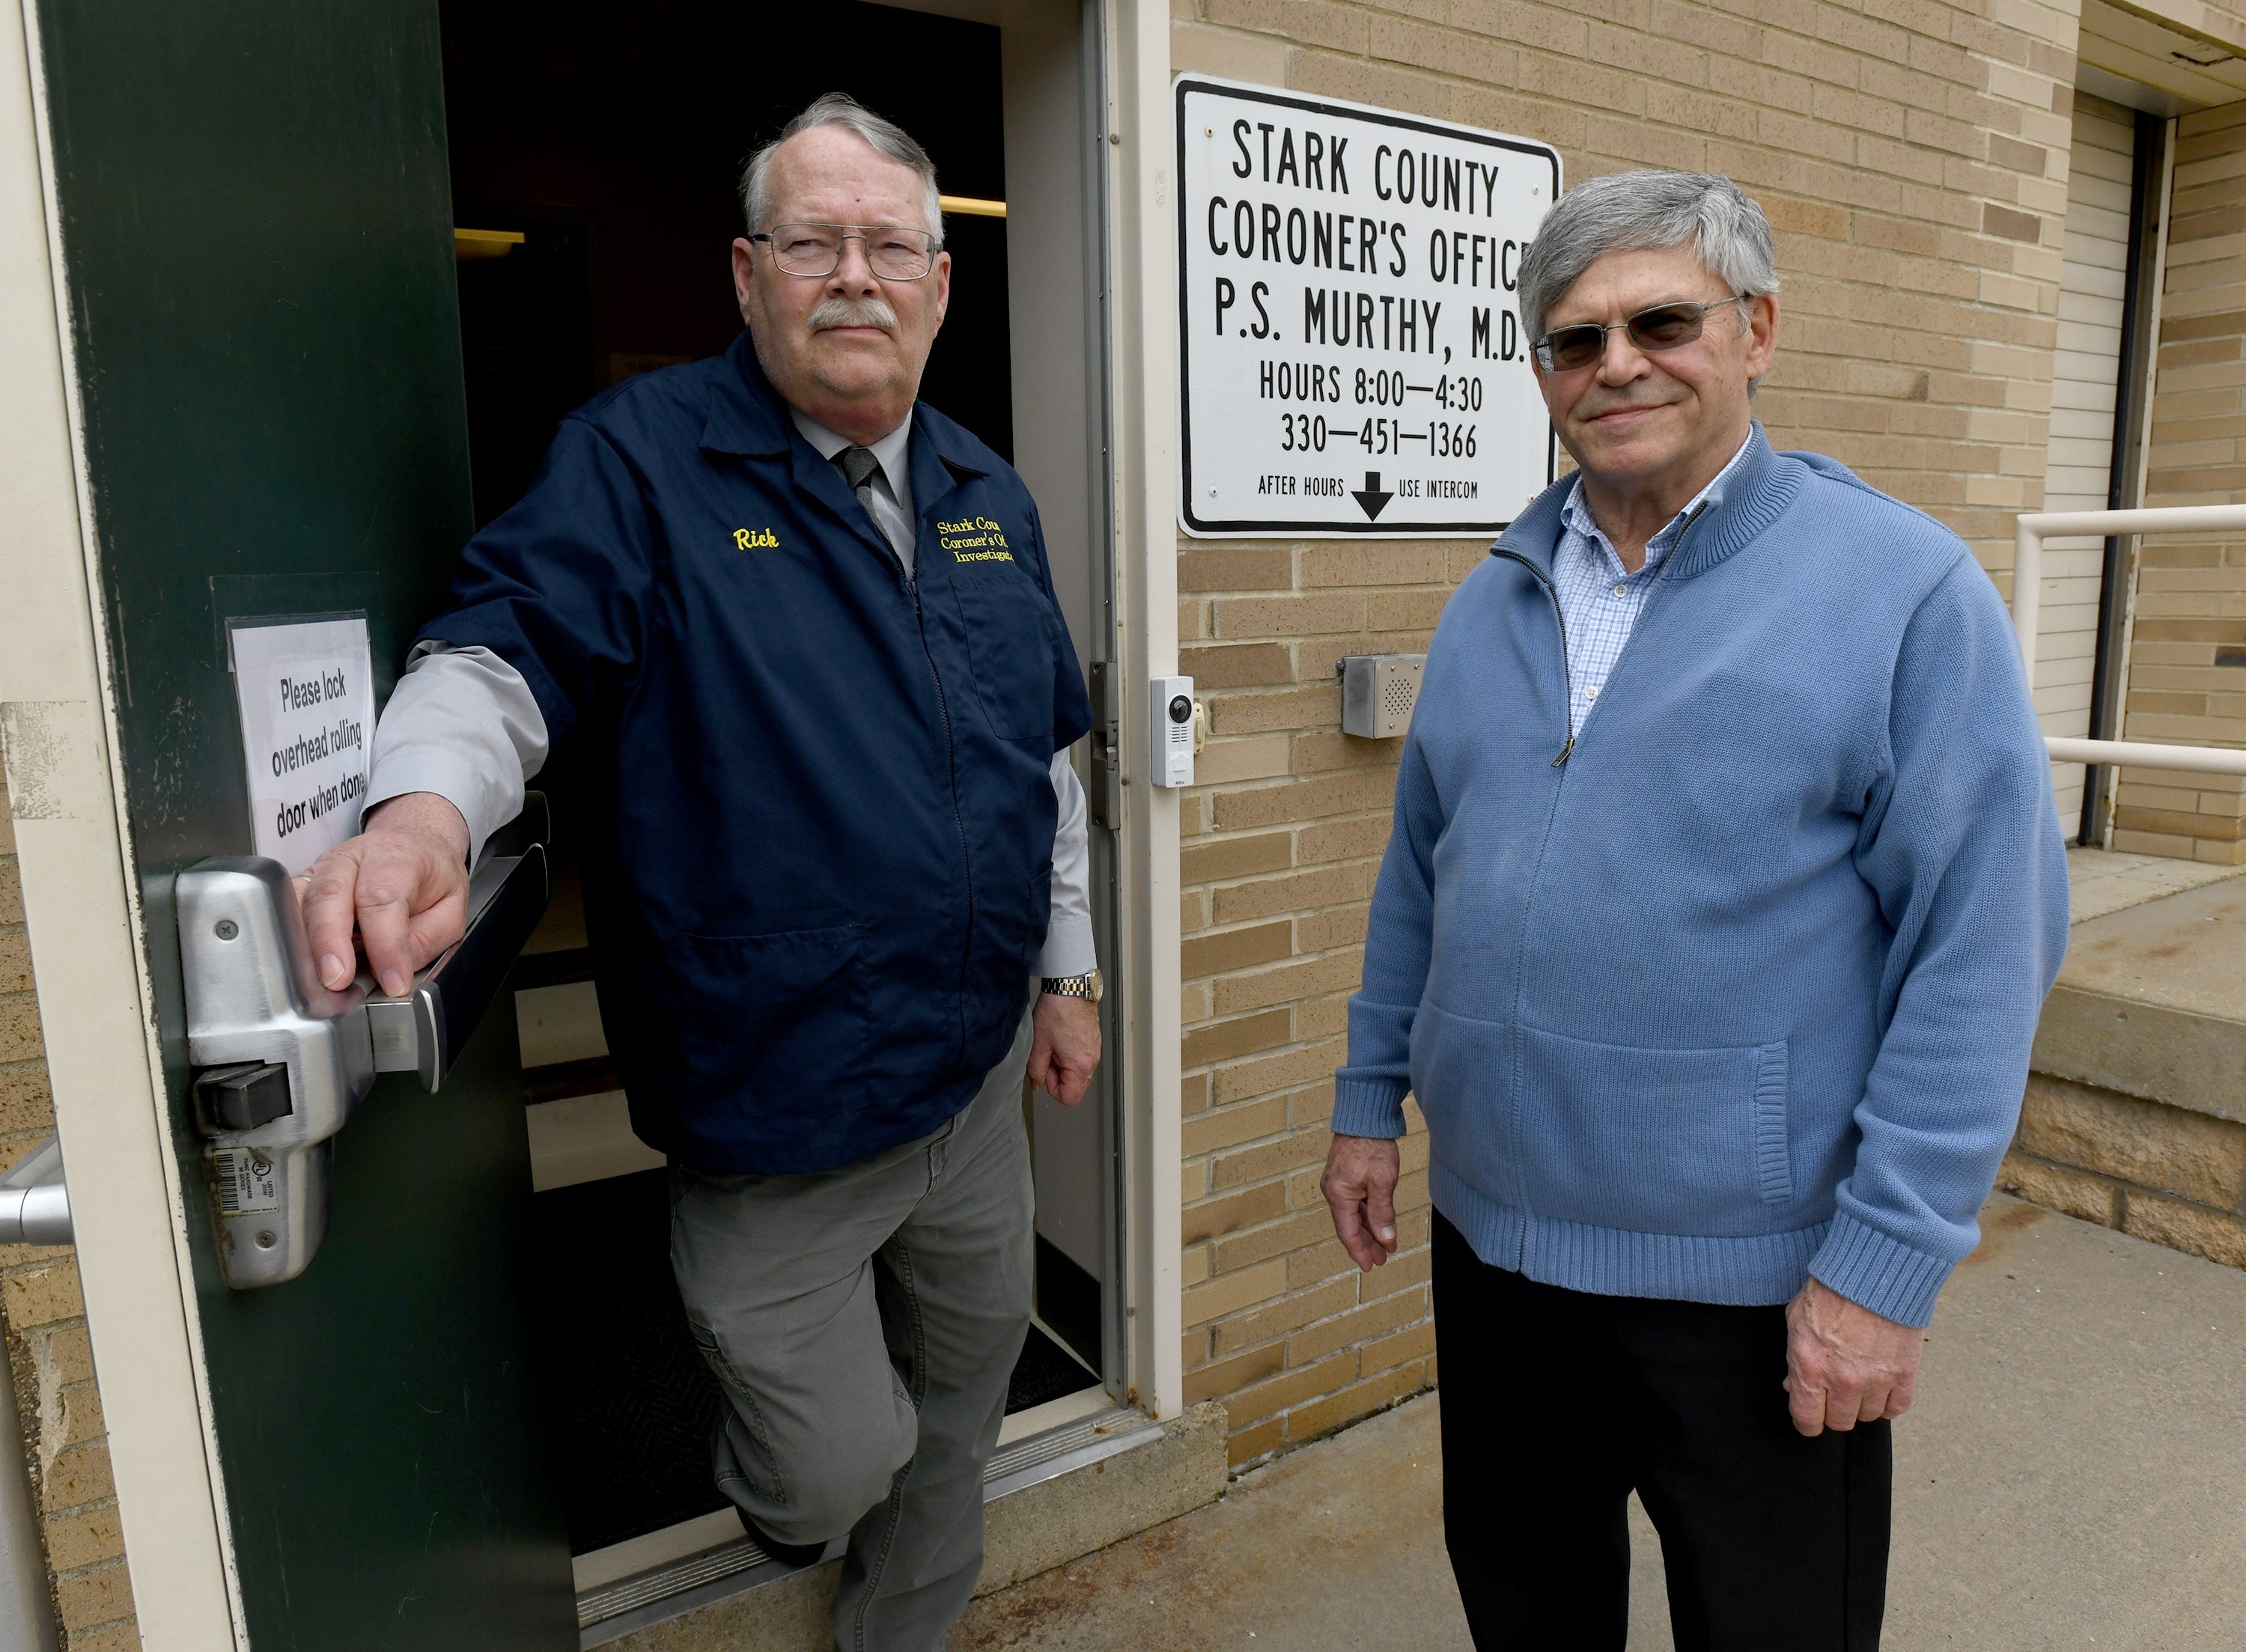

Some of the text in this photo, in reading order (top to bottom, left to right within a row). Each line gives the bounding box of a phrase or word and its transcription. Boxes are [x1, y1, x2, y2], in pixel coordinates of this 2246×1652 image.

[1232, 118, 1499, 218] STARK COUNTY
[1208, 195, 1533, 292] CORONER'S OFFIC
[1215, 276, 1525, 365] P.S. MURTHY, M.D.
[1260, 360, 1341, 403] HOURS
[1258, 475, 1478, 499] AFTER HOURS USE INTERCOM
[732, 527, 779, 552] Rick
[937, 517, 976, 534] Stark
[940, 531, 994, 550] Coroner's
[280, 667, 347, 713] Please lock
[272, 718, 362, 778] overhead rolling
[276, 772, 366, 838] door when done
[245, 1172, 253, 1199] HARDWARE
